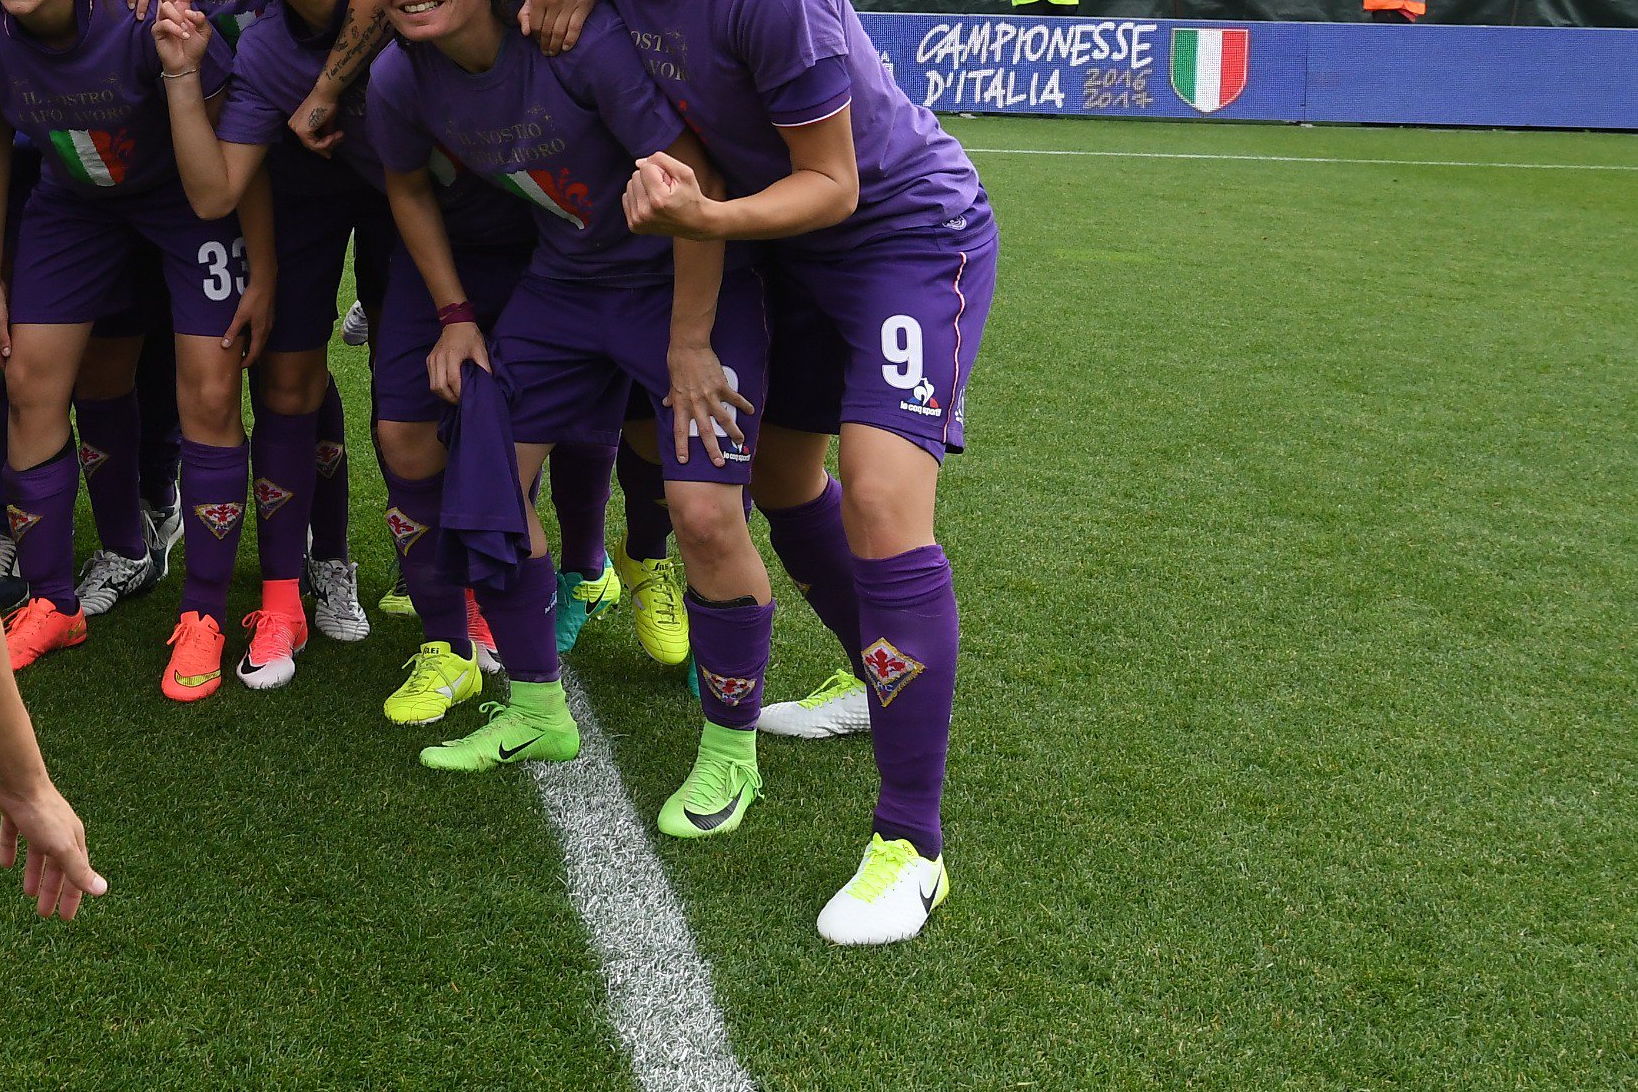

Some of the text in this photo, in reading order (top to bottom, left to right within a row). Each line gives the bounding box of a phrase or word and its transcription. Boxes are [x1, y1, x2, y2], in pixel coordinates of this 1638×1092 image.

[916, 21, 1158, 69] CAMPIONESSE
[924, 68, 1065, 108] D'ITALIA
[1084, 68, 1151, 89] 2016
[880, 313, 924, 390] 9
